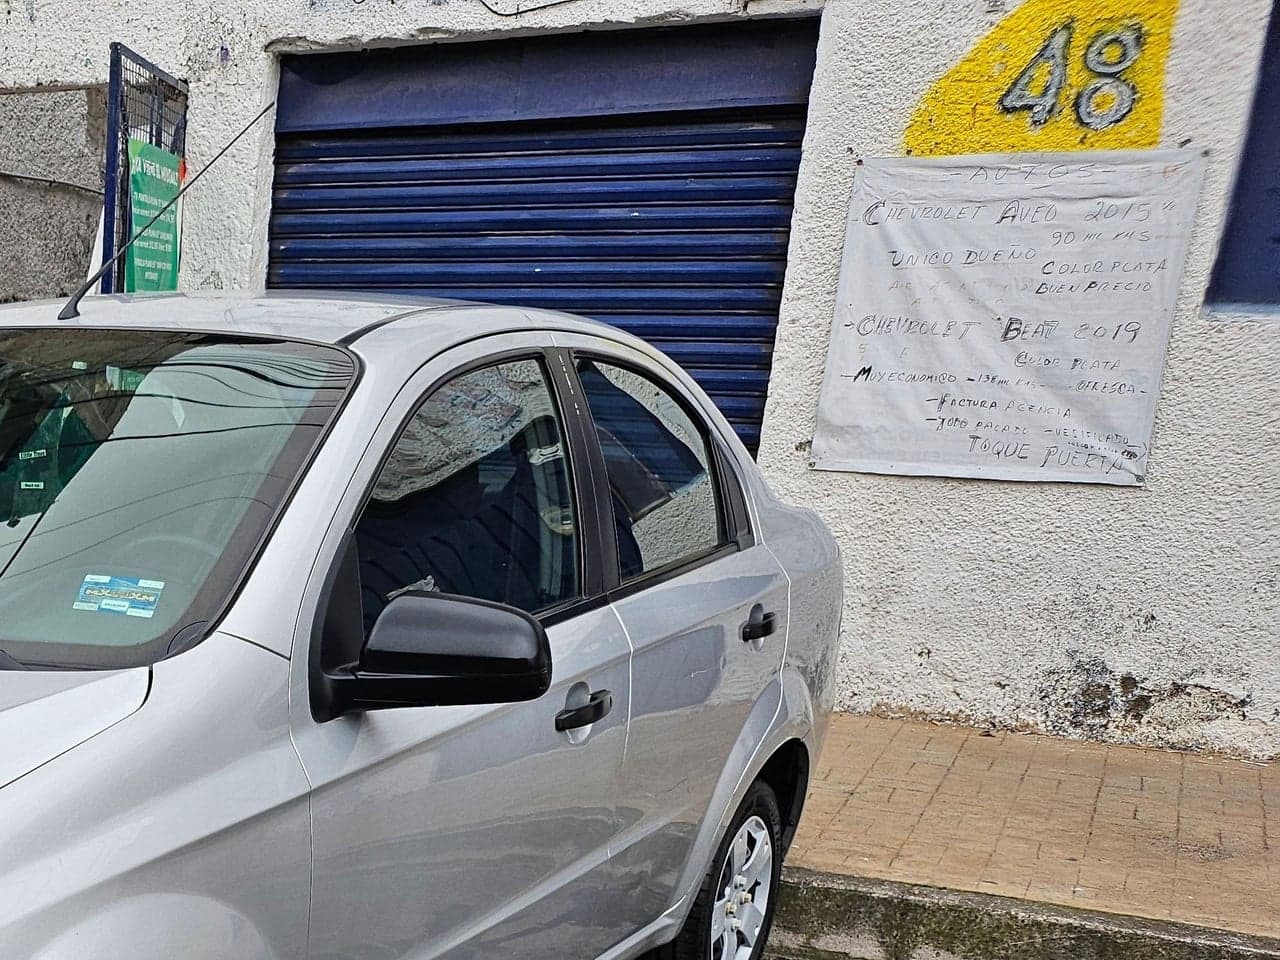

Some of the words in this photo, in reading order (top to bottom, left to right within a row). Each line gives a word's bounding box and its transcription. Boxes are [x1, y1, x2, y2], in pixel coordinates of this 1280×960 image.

[996, 15, 1146, 131] 48
[862, 200, 982, 226] CHEVROLET
[995, 201, 1058, 226] AVEO
[1083, 202, 1151, 222] 2015
[1050, 230, 1076, 247] 90
[887, 250, 954, 267] UNICO
[964, 243, 1037, 266] DUEÑO
[1041, 261, 1104, 276] COLOR
[1110, 260, 1168, 275] PLATA
[1034, 280, 1083, 296] BUEN
[1082, 279, 1153, 295] PRECIO
[855, 315, 982, 340] CHEVROLET
[1000, 316, 1060, 343] BEAT
[1073, 319, 1142, 344] 2019
[968, 434, 1030, 460] TOQUE
[1040, 445, 1123, 474] PUERTA
